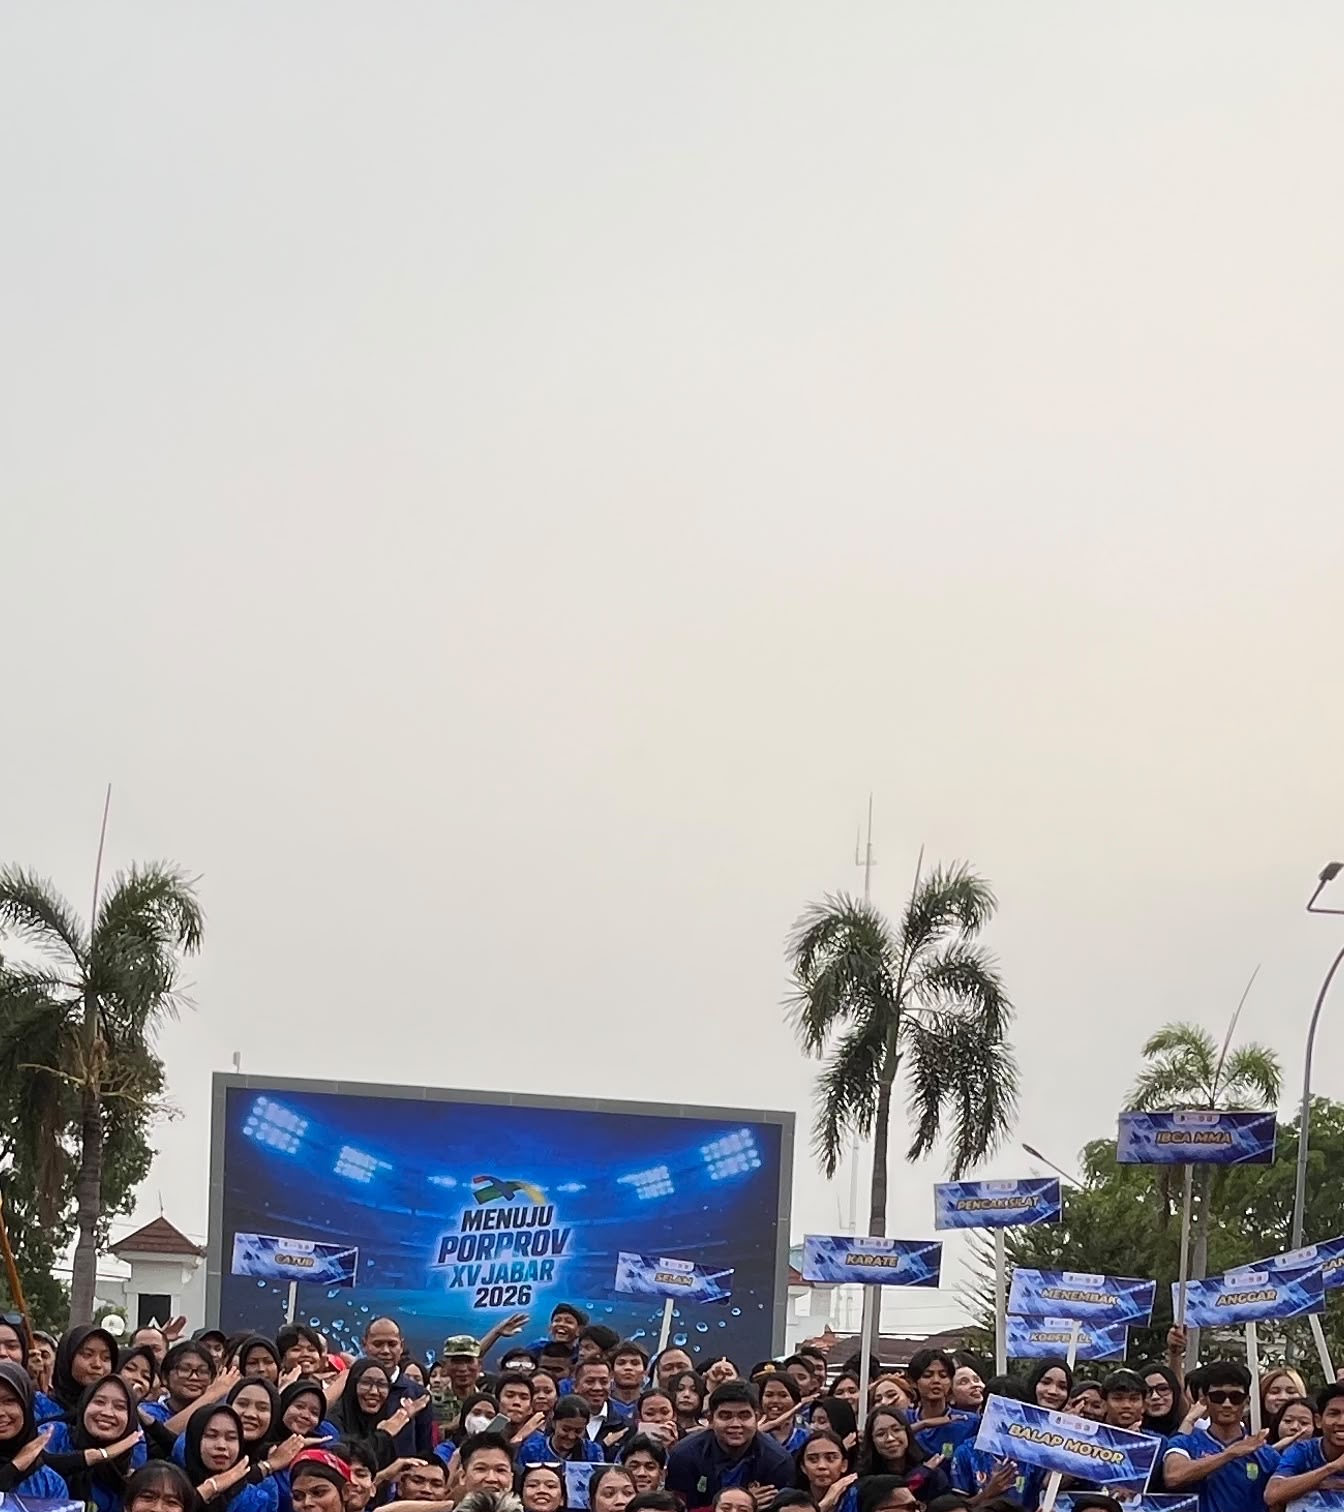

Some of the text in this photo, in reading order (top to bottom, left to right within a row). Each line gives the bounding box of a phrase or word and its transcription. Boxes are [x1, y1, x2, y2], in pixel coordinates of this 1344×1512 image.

[1157, 1131, 1233, 1144] IBCA MMA
[957, 1195, 1040, 1211] PENCAK SILAT
[461, 1206, 553, 1232] MENUJU
[438, 1228, 571, 1263] PORPROV
[844, 1254, 898, 1268] KARATE
[450, 1259, 554, 1288] XV JABAR
[474, 1285, 532, 1308] 2026
[1041, 1288, 1120, 1305] MENEMBAK
[1215, 1289, 1278, 1307] ANGGAR
[1030, 1332, 1092, 1343] KORFBLL
[1008, 1423, 1125, 1465] BALAP MOTOR
